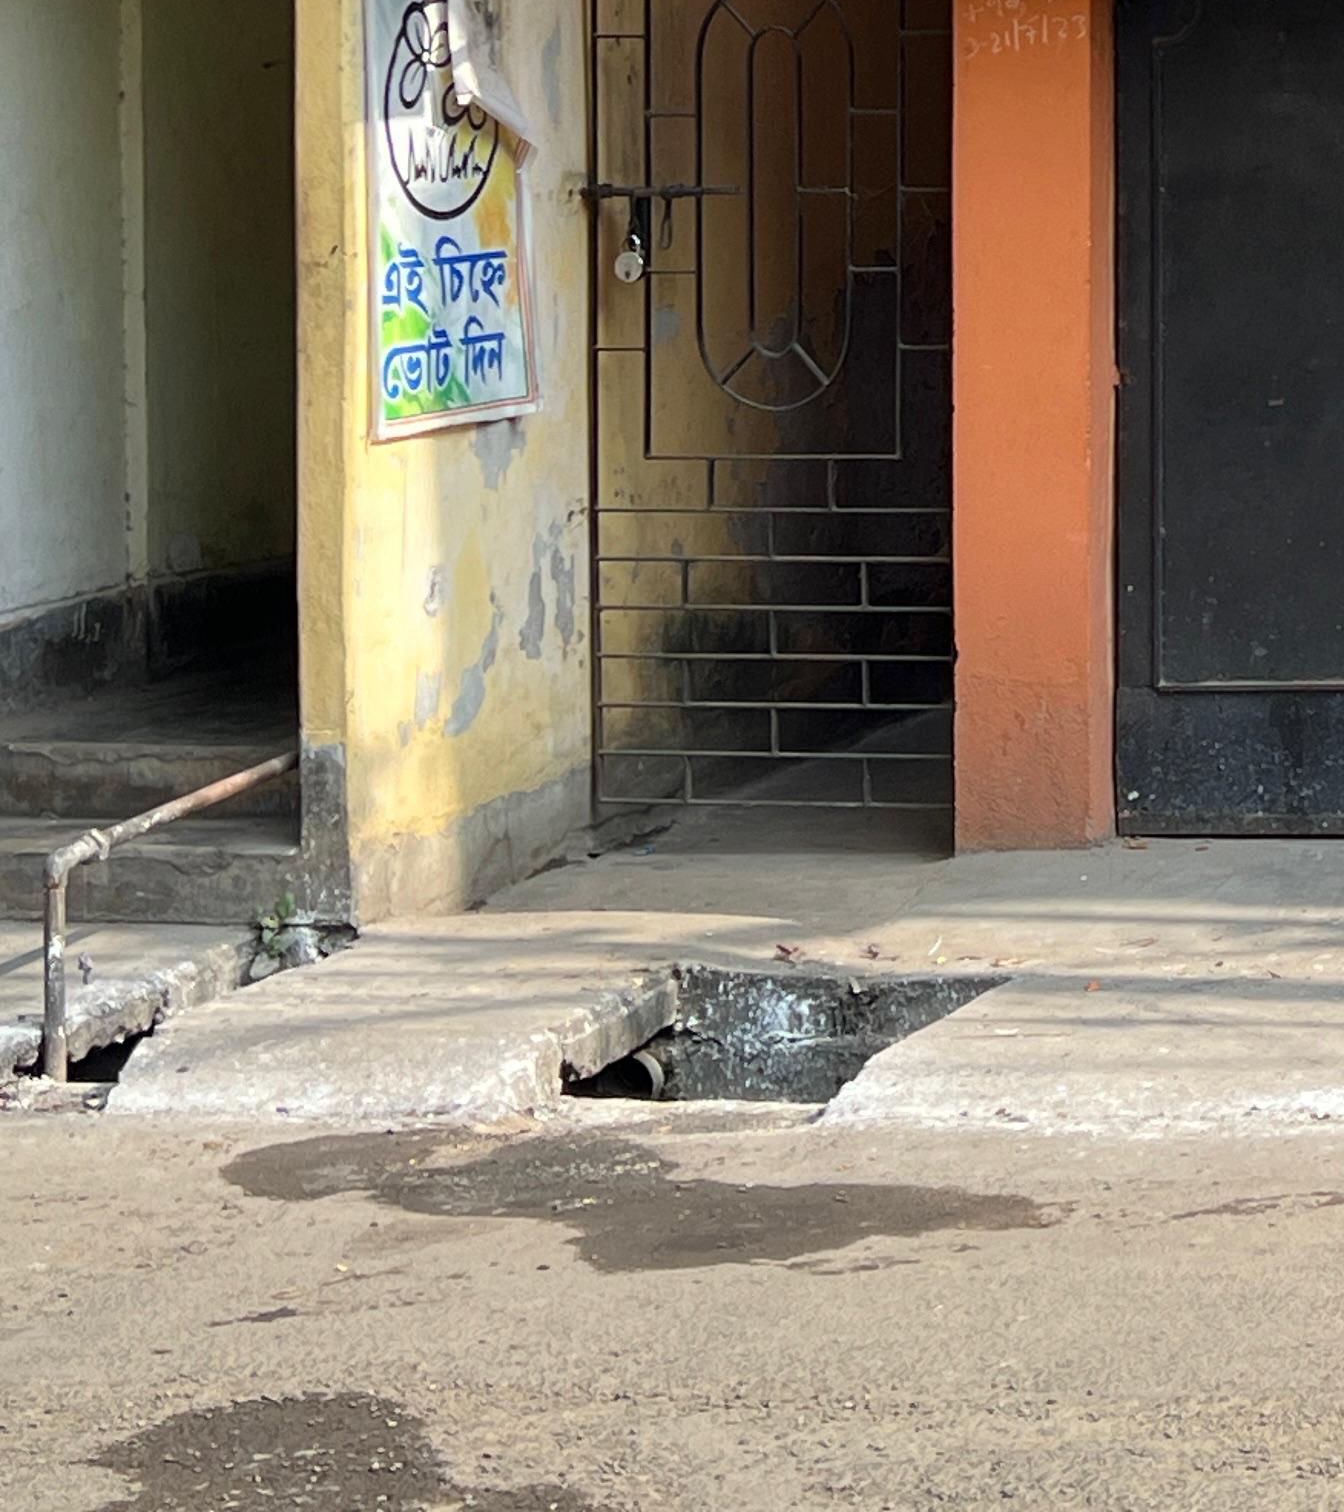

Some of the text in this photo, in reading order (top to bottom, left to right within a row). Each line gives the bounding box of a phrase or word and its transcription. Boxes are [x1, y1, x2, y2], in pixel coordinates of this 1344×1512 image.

[382, 242, 428, 316] এই
[383, 315, 506, 399] ভোট দিন
